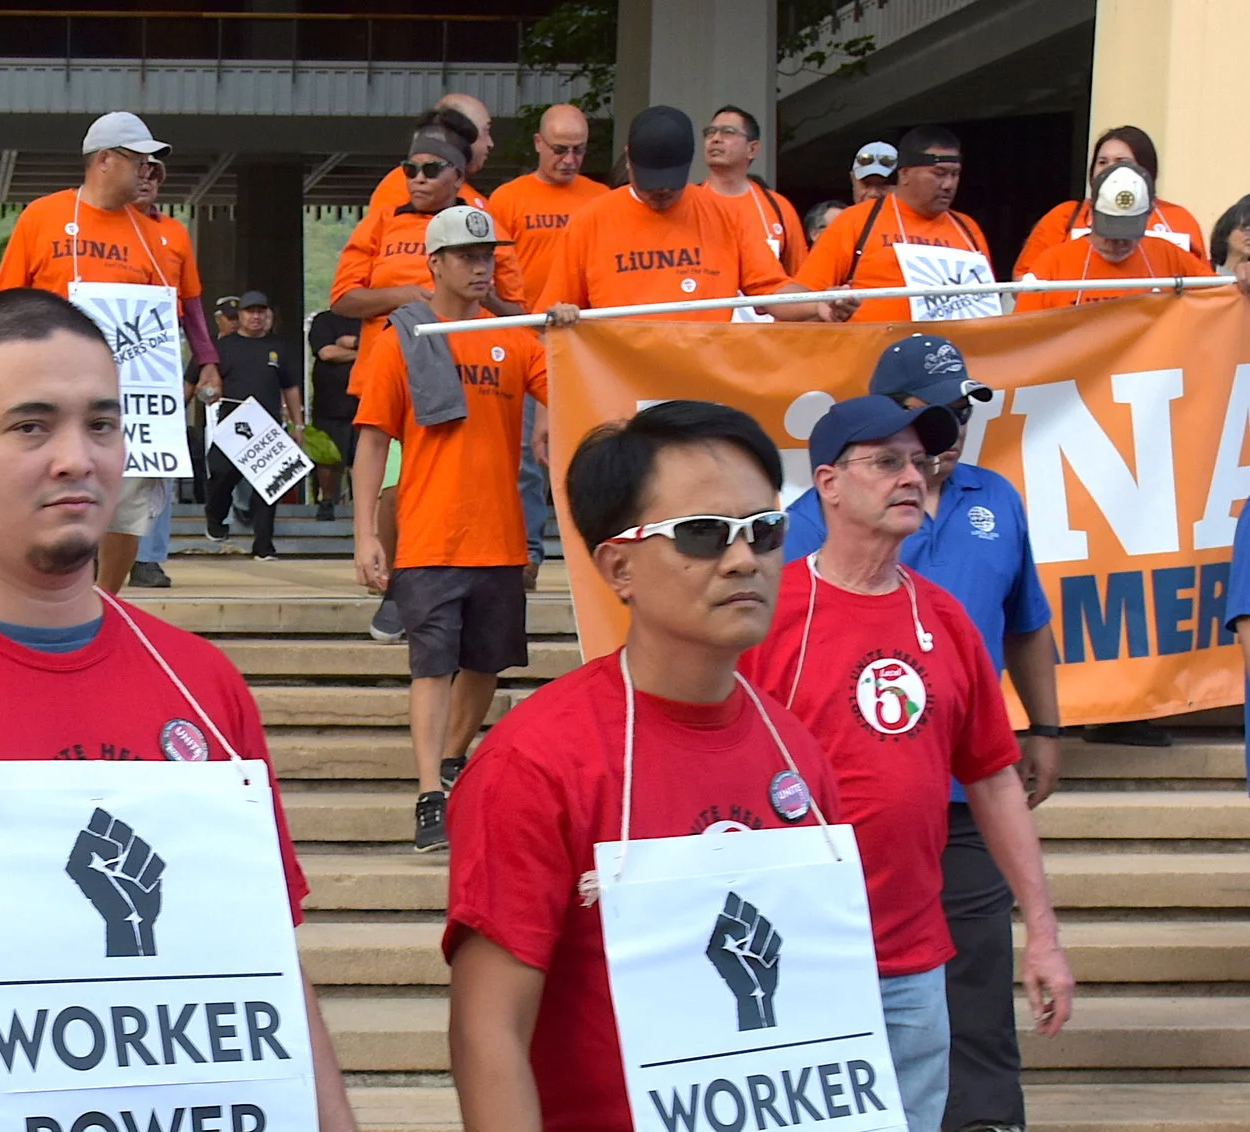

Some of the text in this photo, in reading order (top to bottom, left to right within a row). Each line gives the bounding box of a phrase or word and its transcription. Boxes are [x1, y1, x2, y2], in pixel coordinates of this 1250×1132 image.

[525, 213, 570, 230] LiUN
[52, 238, 129, 262] LiUNA!
[384, 241, 427, 257] LiU
[615, 247, 701, 273] LiUNA!
[116, 315, 143, 353] AY
[112, 331, 170, 365] RKERS DAY
[124, 393, 178, 416] ITED
[237, 427, 281, 466] WORKER
[250, 441, 287, 475] POWER
[125, 451, 179, 473] AND
